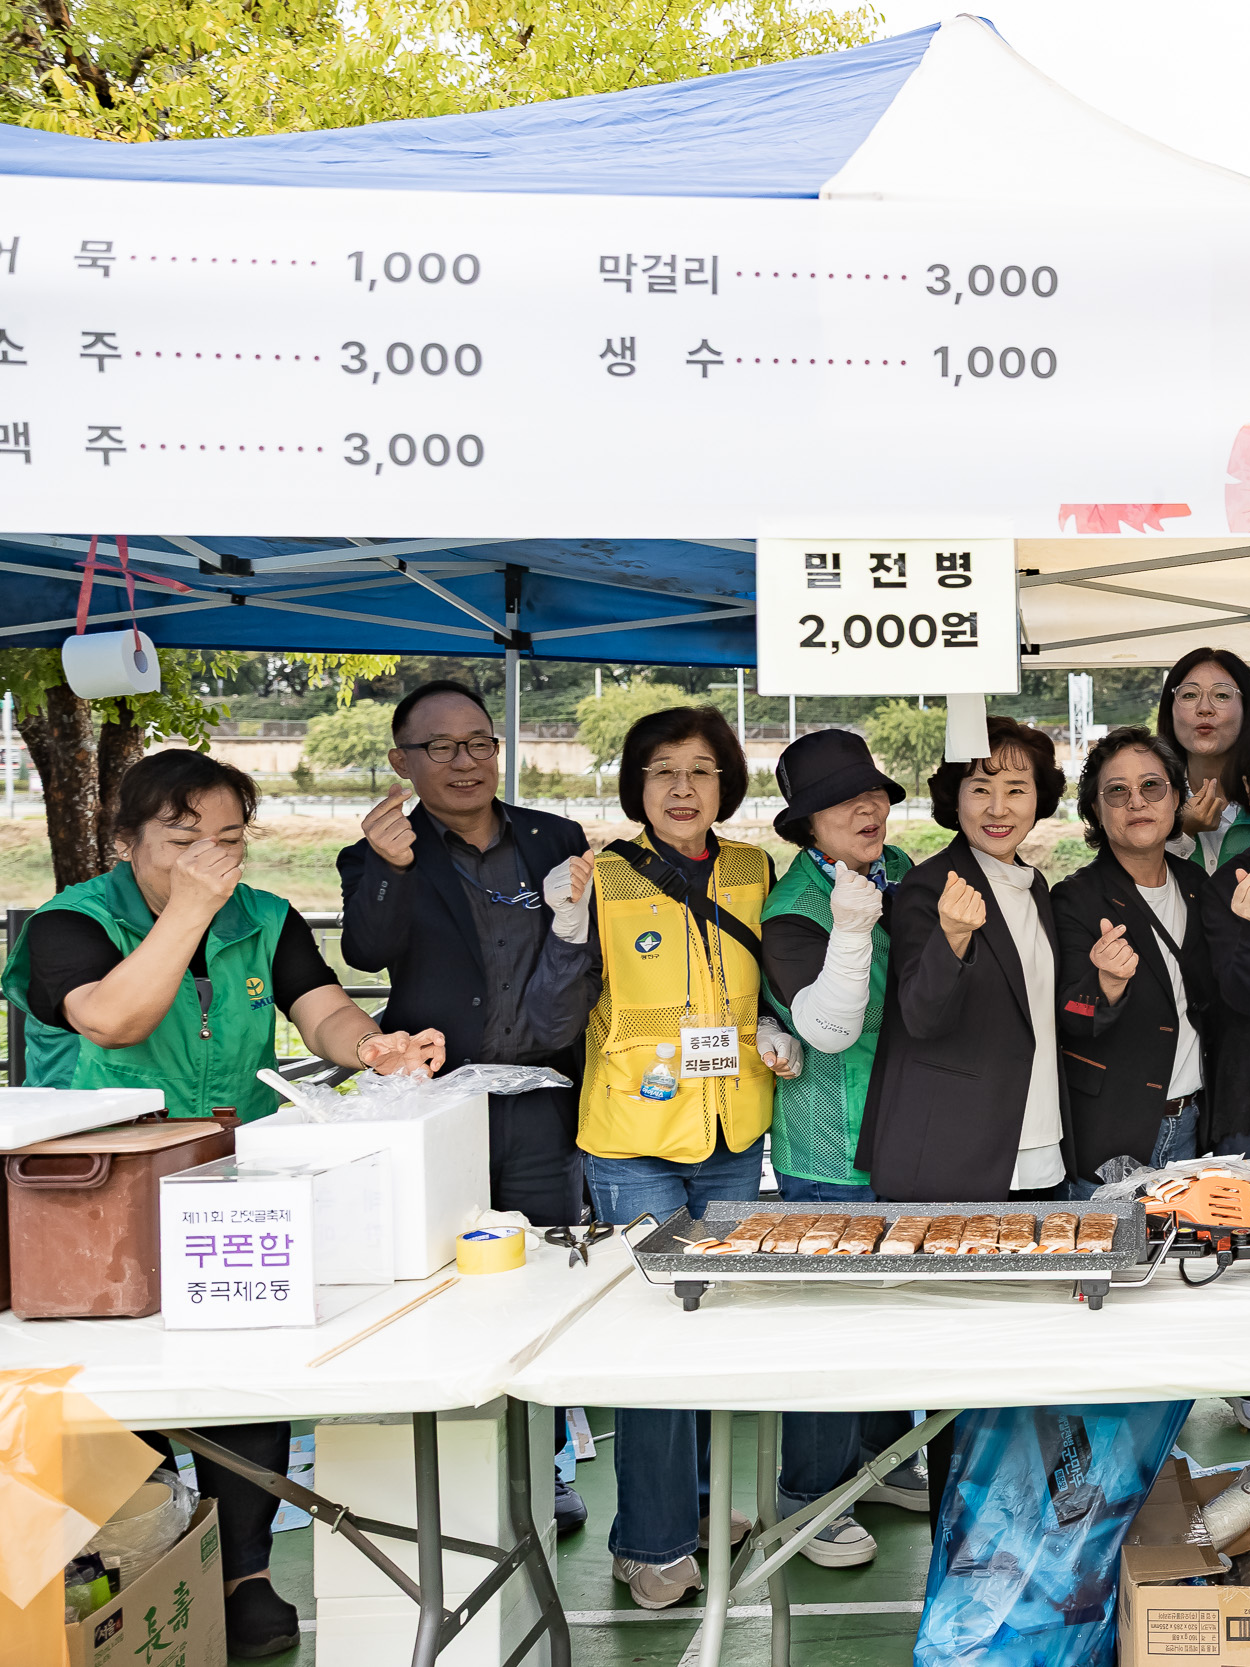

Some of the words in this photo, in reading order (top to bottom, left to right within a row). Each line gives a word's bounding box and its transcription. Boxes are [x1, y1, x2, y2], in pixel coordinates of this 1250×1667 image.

[74, 240, 116, 278] 묵
[347, 251, 481, 292] 1,000
[599, 253, 720, 295] 막걸리
[925, 263, 1059, 305] 3,000
[79, 331, 122, 373] 주
[341, 341, 483, 385] 3,000
[600, 336, 637, 376] 생
[685, 338, 725, 378] 수
[932, 345, 1058, 387] 1,000
[85, 425, 127, 467] 주
[343, 433, 485, 476] 3,000
[799, 611, 978, 654] 2,000원
[690, 1034, 730, 1050] 중곡2동
[685, 1056, 737, 1071] 직능단체
[182, 1210, 224, 1224] 제11회
[185, 1232, 294, 1269] 쿠폰함
[187, 1280, 291, 1304] 중곡제2동
[1061, 1446, 1086, 1488] 군만두
